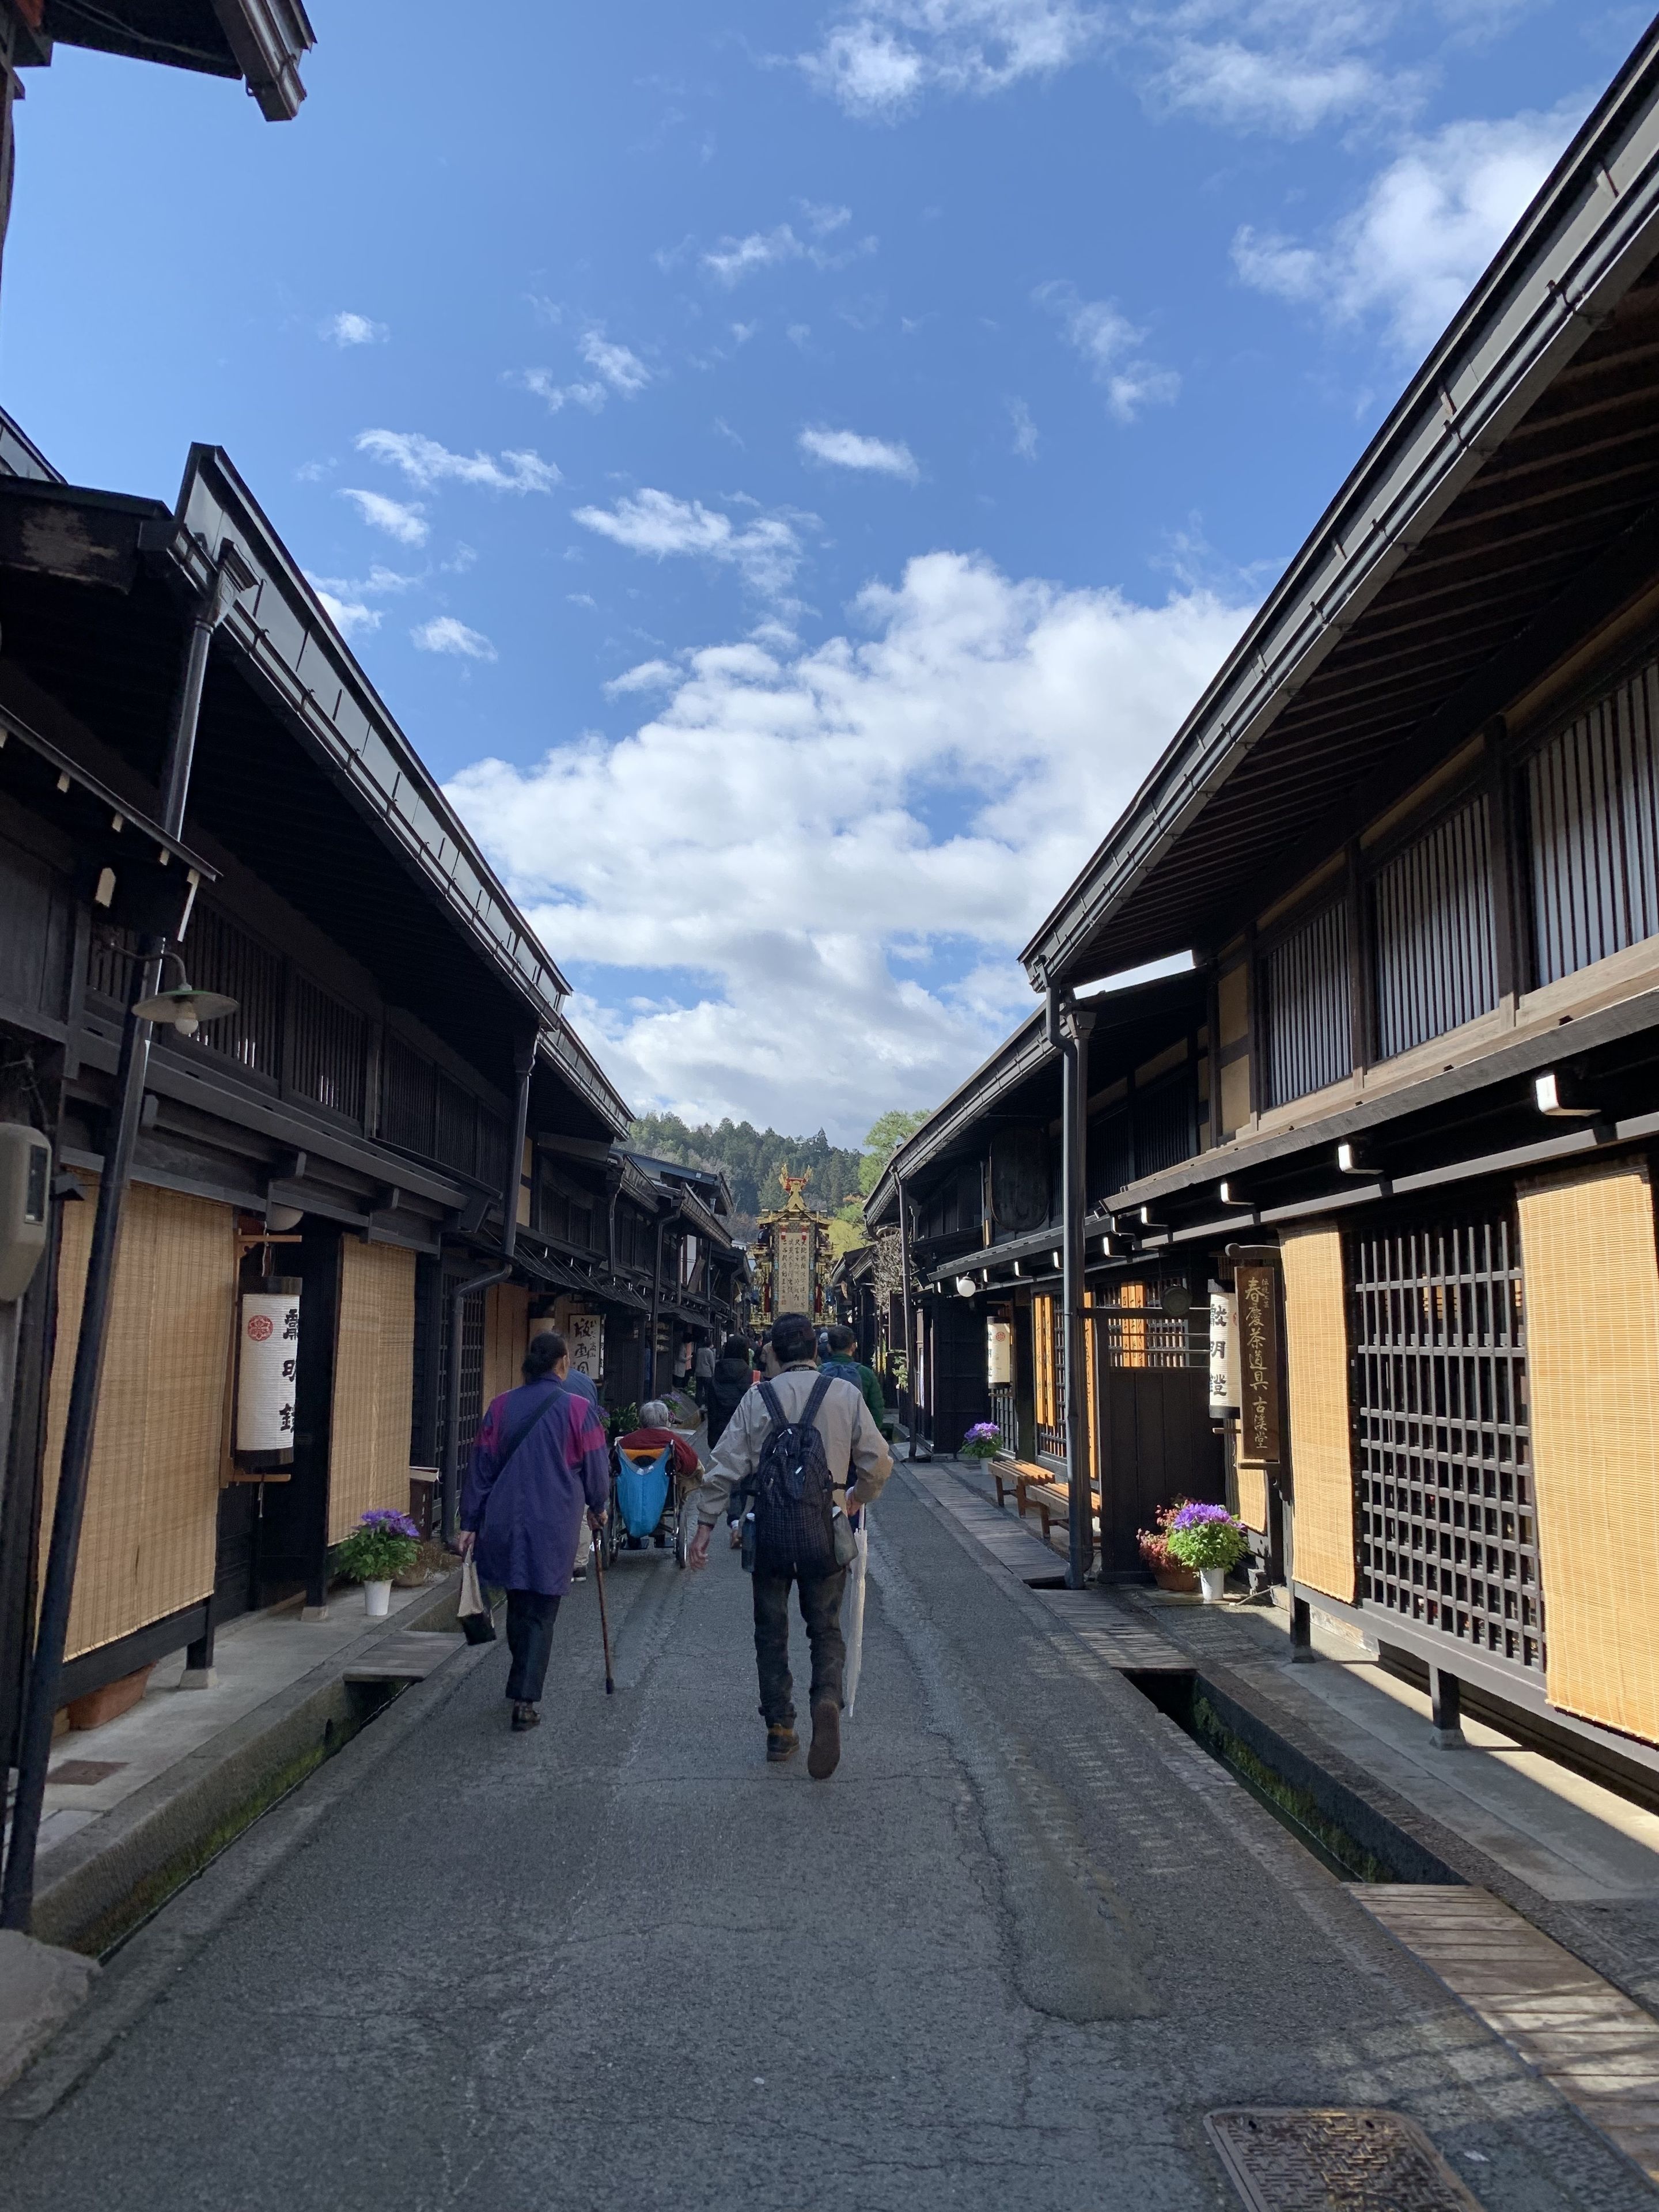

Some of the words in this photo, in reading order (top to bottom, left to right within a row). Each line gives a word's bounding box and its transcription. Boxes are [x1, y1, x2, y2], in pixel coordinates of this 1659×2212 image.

[1245, 1277, 1268, 1391] 春慶茶道具
